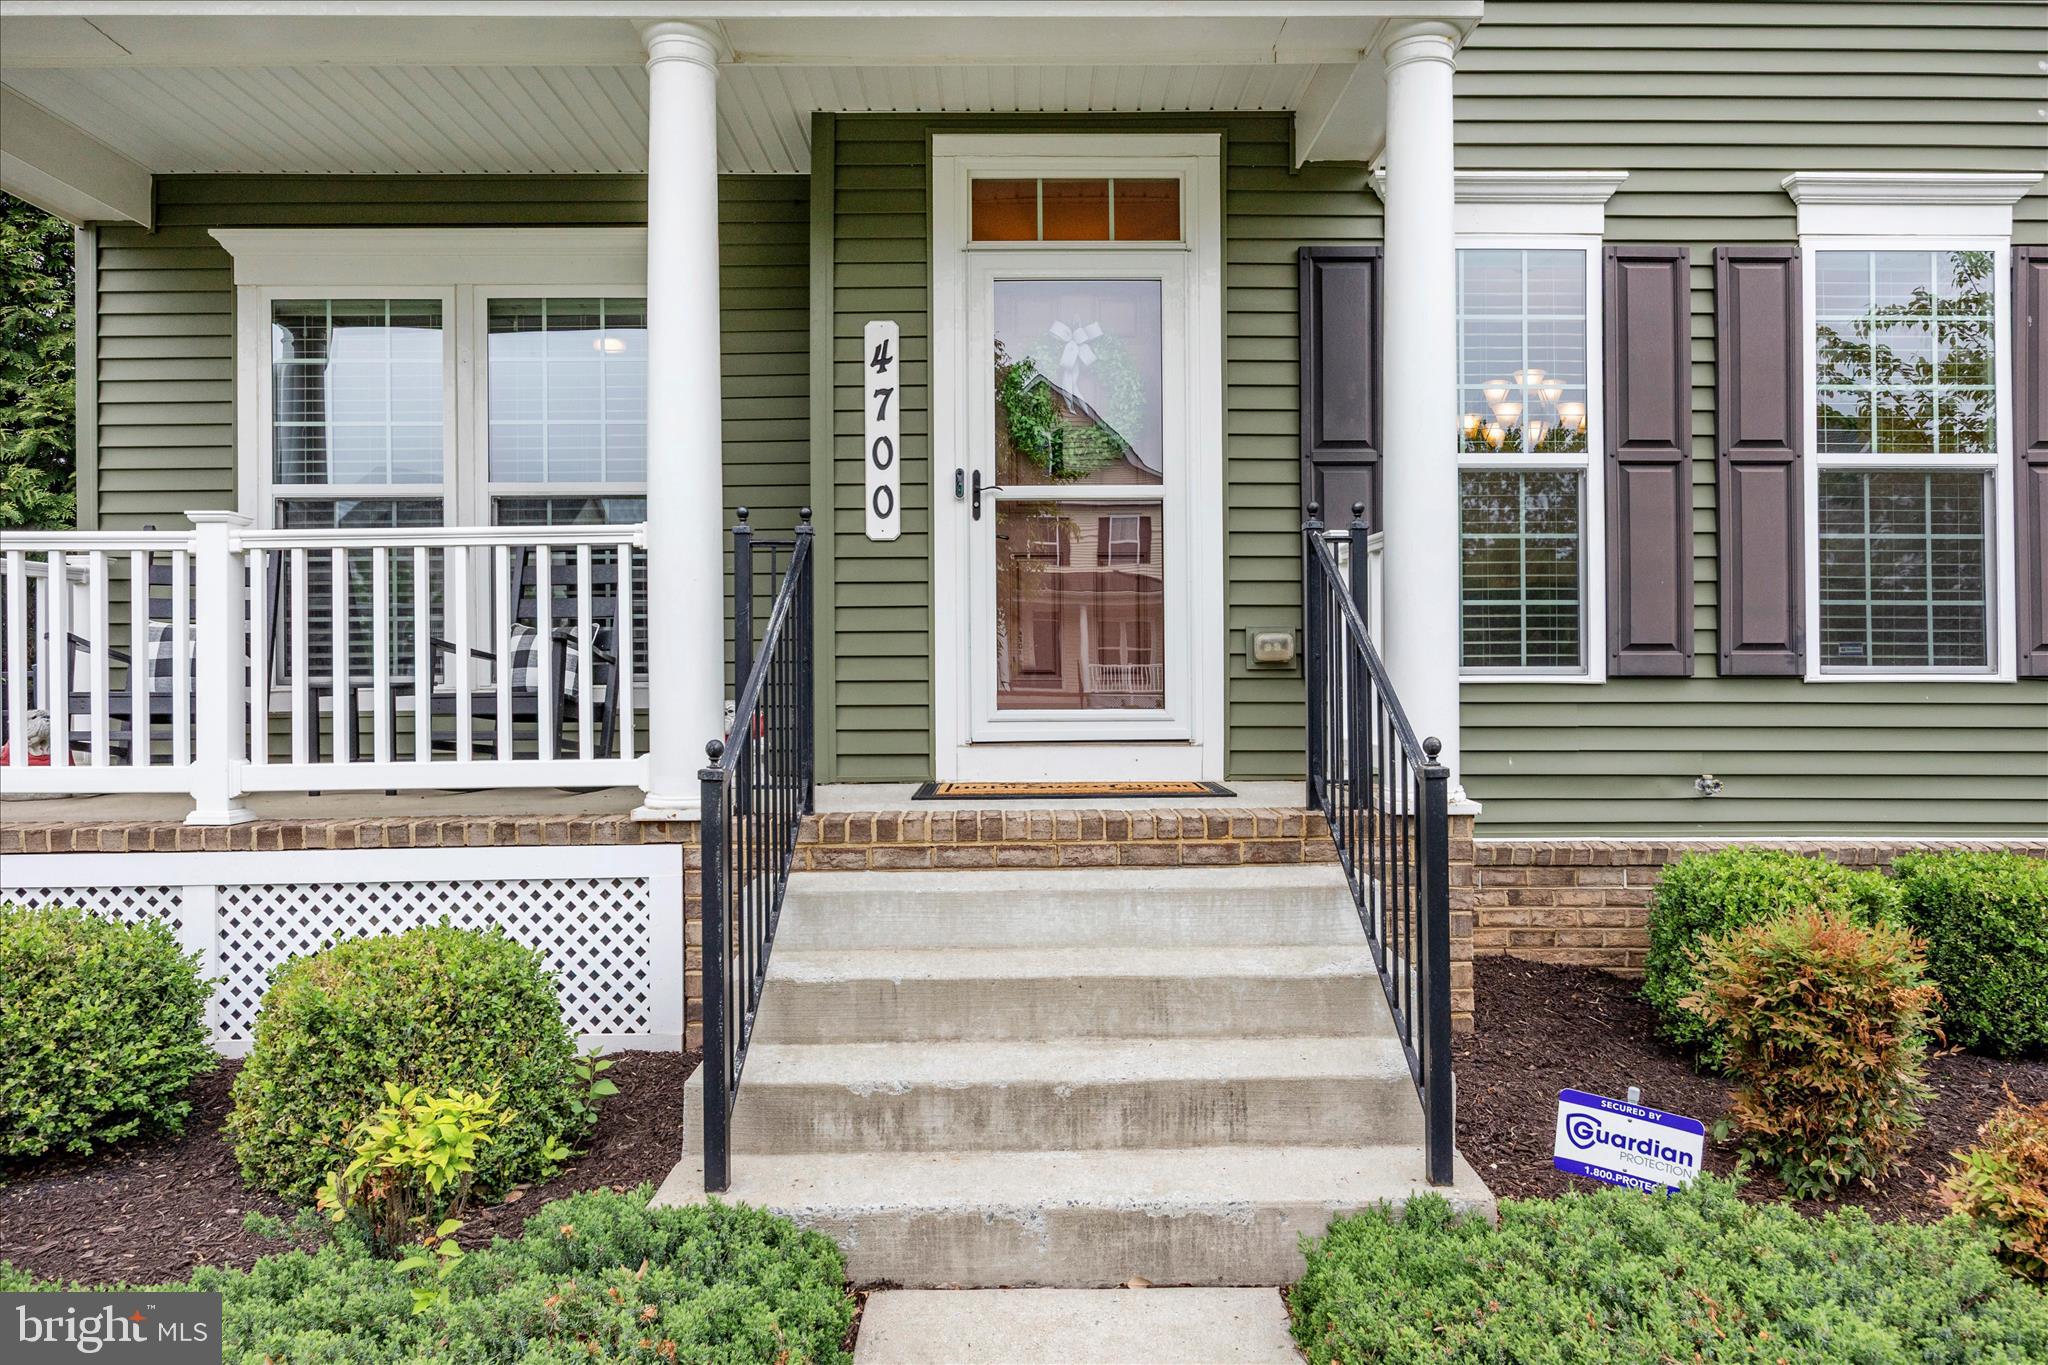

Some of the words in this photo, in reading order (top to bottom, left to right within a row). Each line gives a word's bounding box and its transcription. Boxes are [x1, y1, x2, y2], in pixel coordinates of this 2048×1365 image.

[870, 338, 894, 519] 4700
[1601, 1100, 1646, 1117] SECURED
[1648, 1111, 1662, 1121] BY
[1565, 1112, 1693, 1168] Guardian
[1619, 1151, 1692, 1179] PROTECTION
